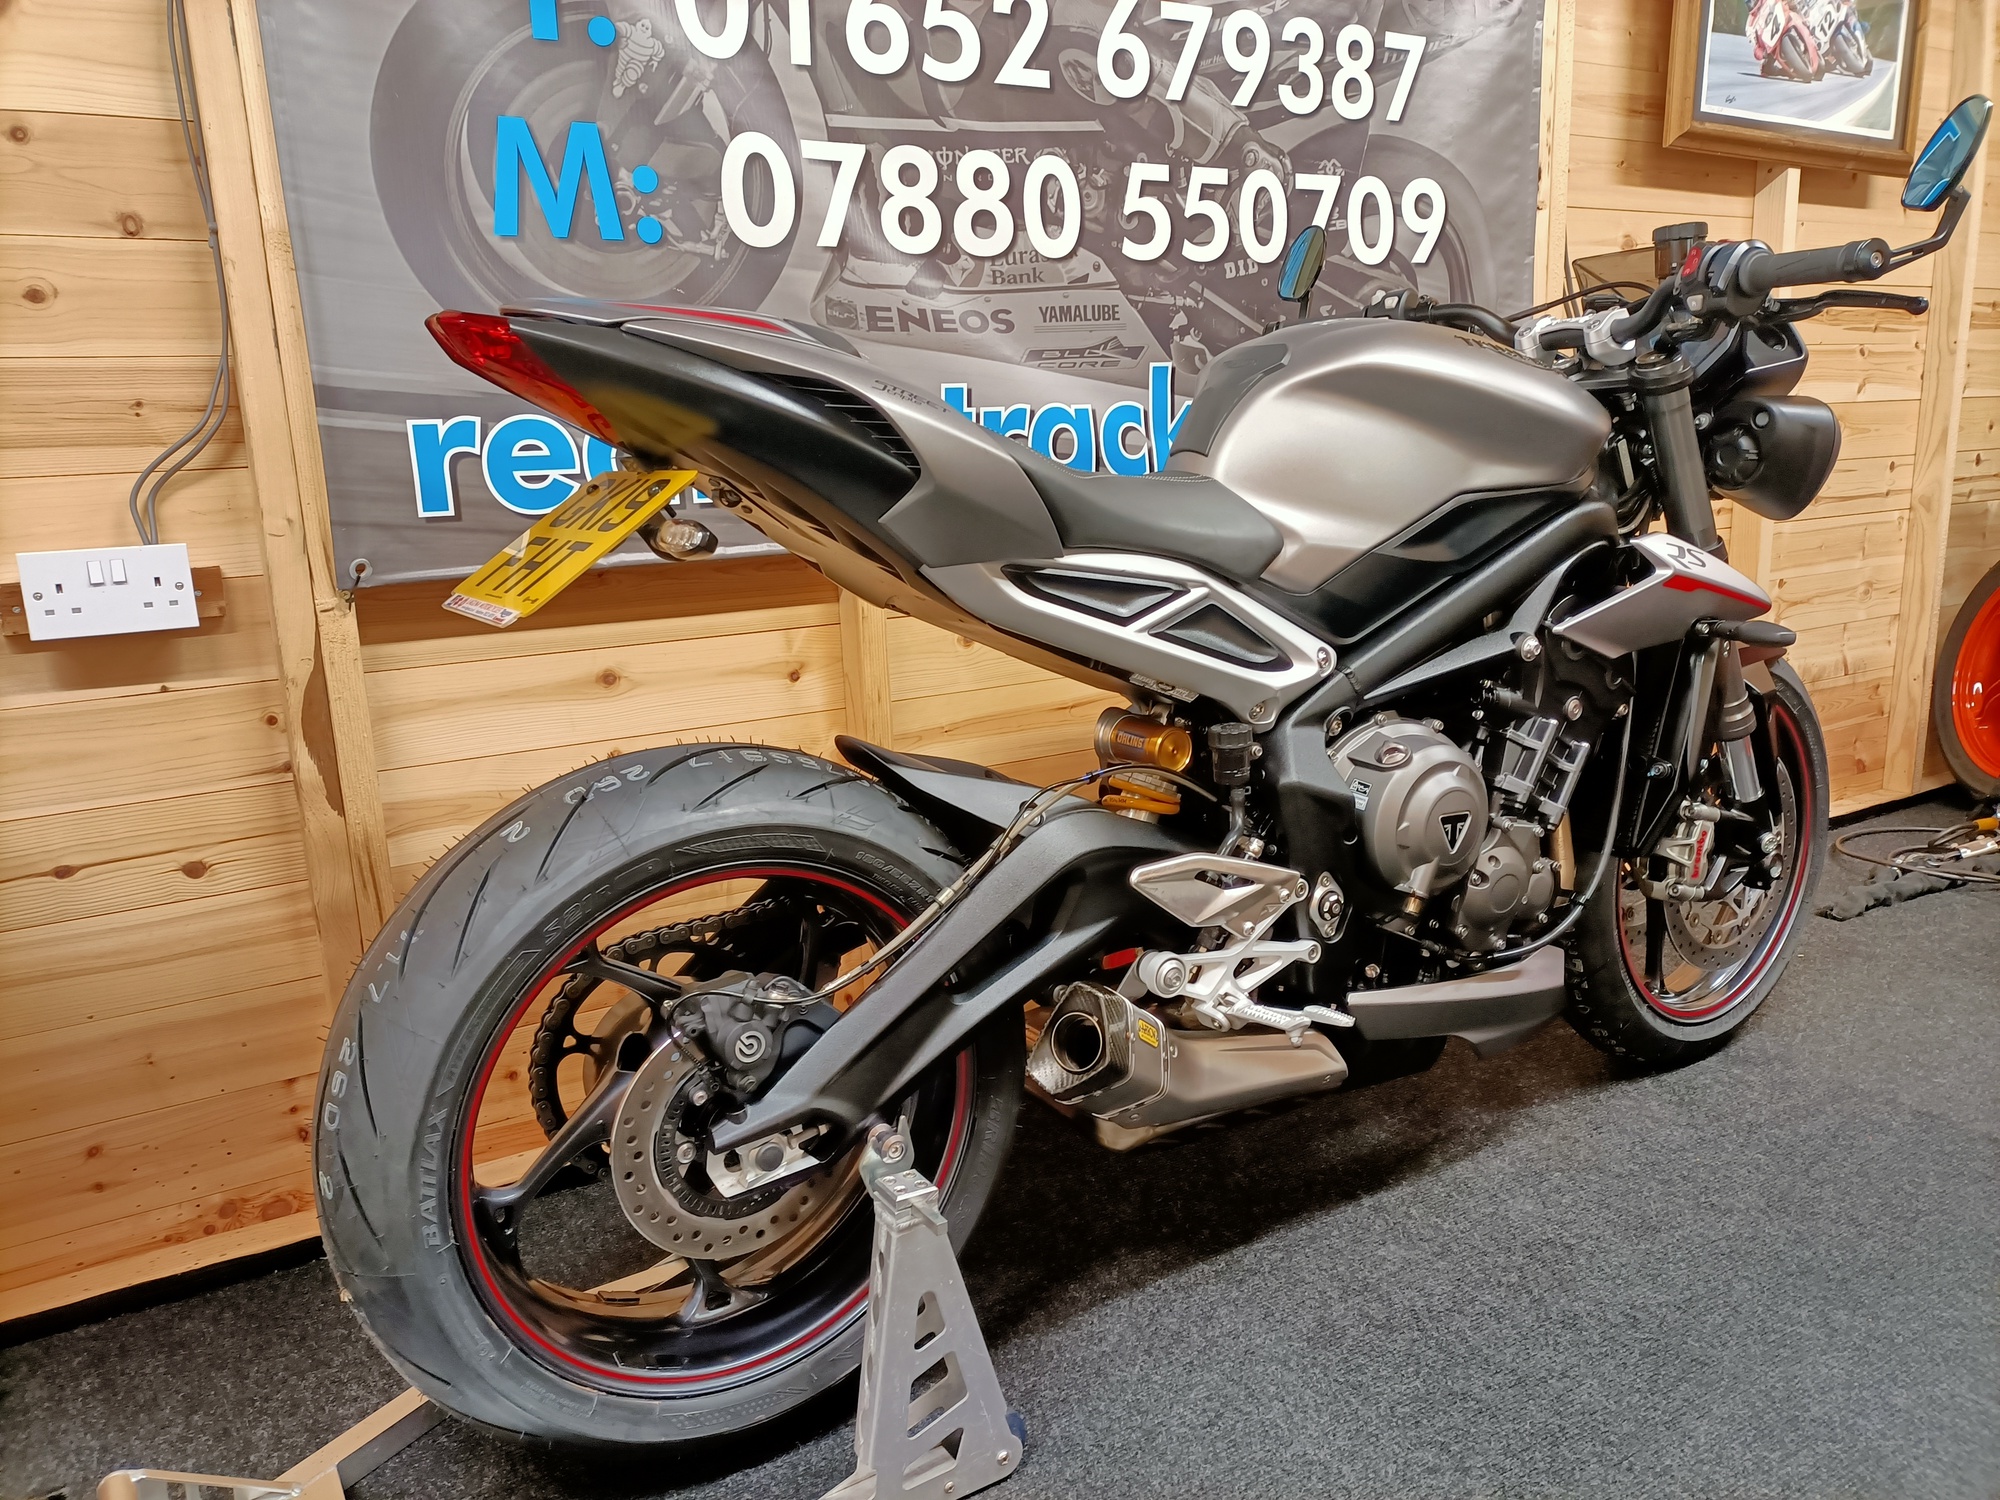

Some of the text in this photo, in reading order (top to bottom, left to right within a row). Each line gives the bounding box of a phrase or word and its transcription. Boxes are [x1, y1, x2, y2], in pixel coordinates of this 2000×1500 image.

[1097, 0, 1427, 122] 679387
[494, 115, 1446, 265] M: 07880 550709
[990, 267, 1045, 285] Bank
[865, 305, 1016, 334] ENEOS
[1038, 304, 1121, 323] YAMALUBE
[1037, 360, 1121, 369] CORE
[549, 478, 672, 532] GK19
[475, 536, 594, 597] FHT
[1666, 542, 1707, 570] RS
[422, 1107, 449, 1250] BATTLAX
